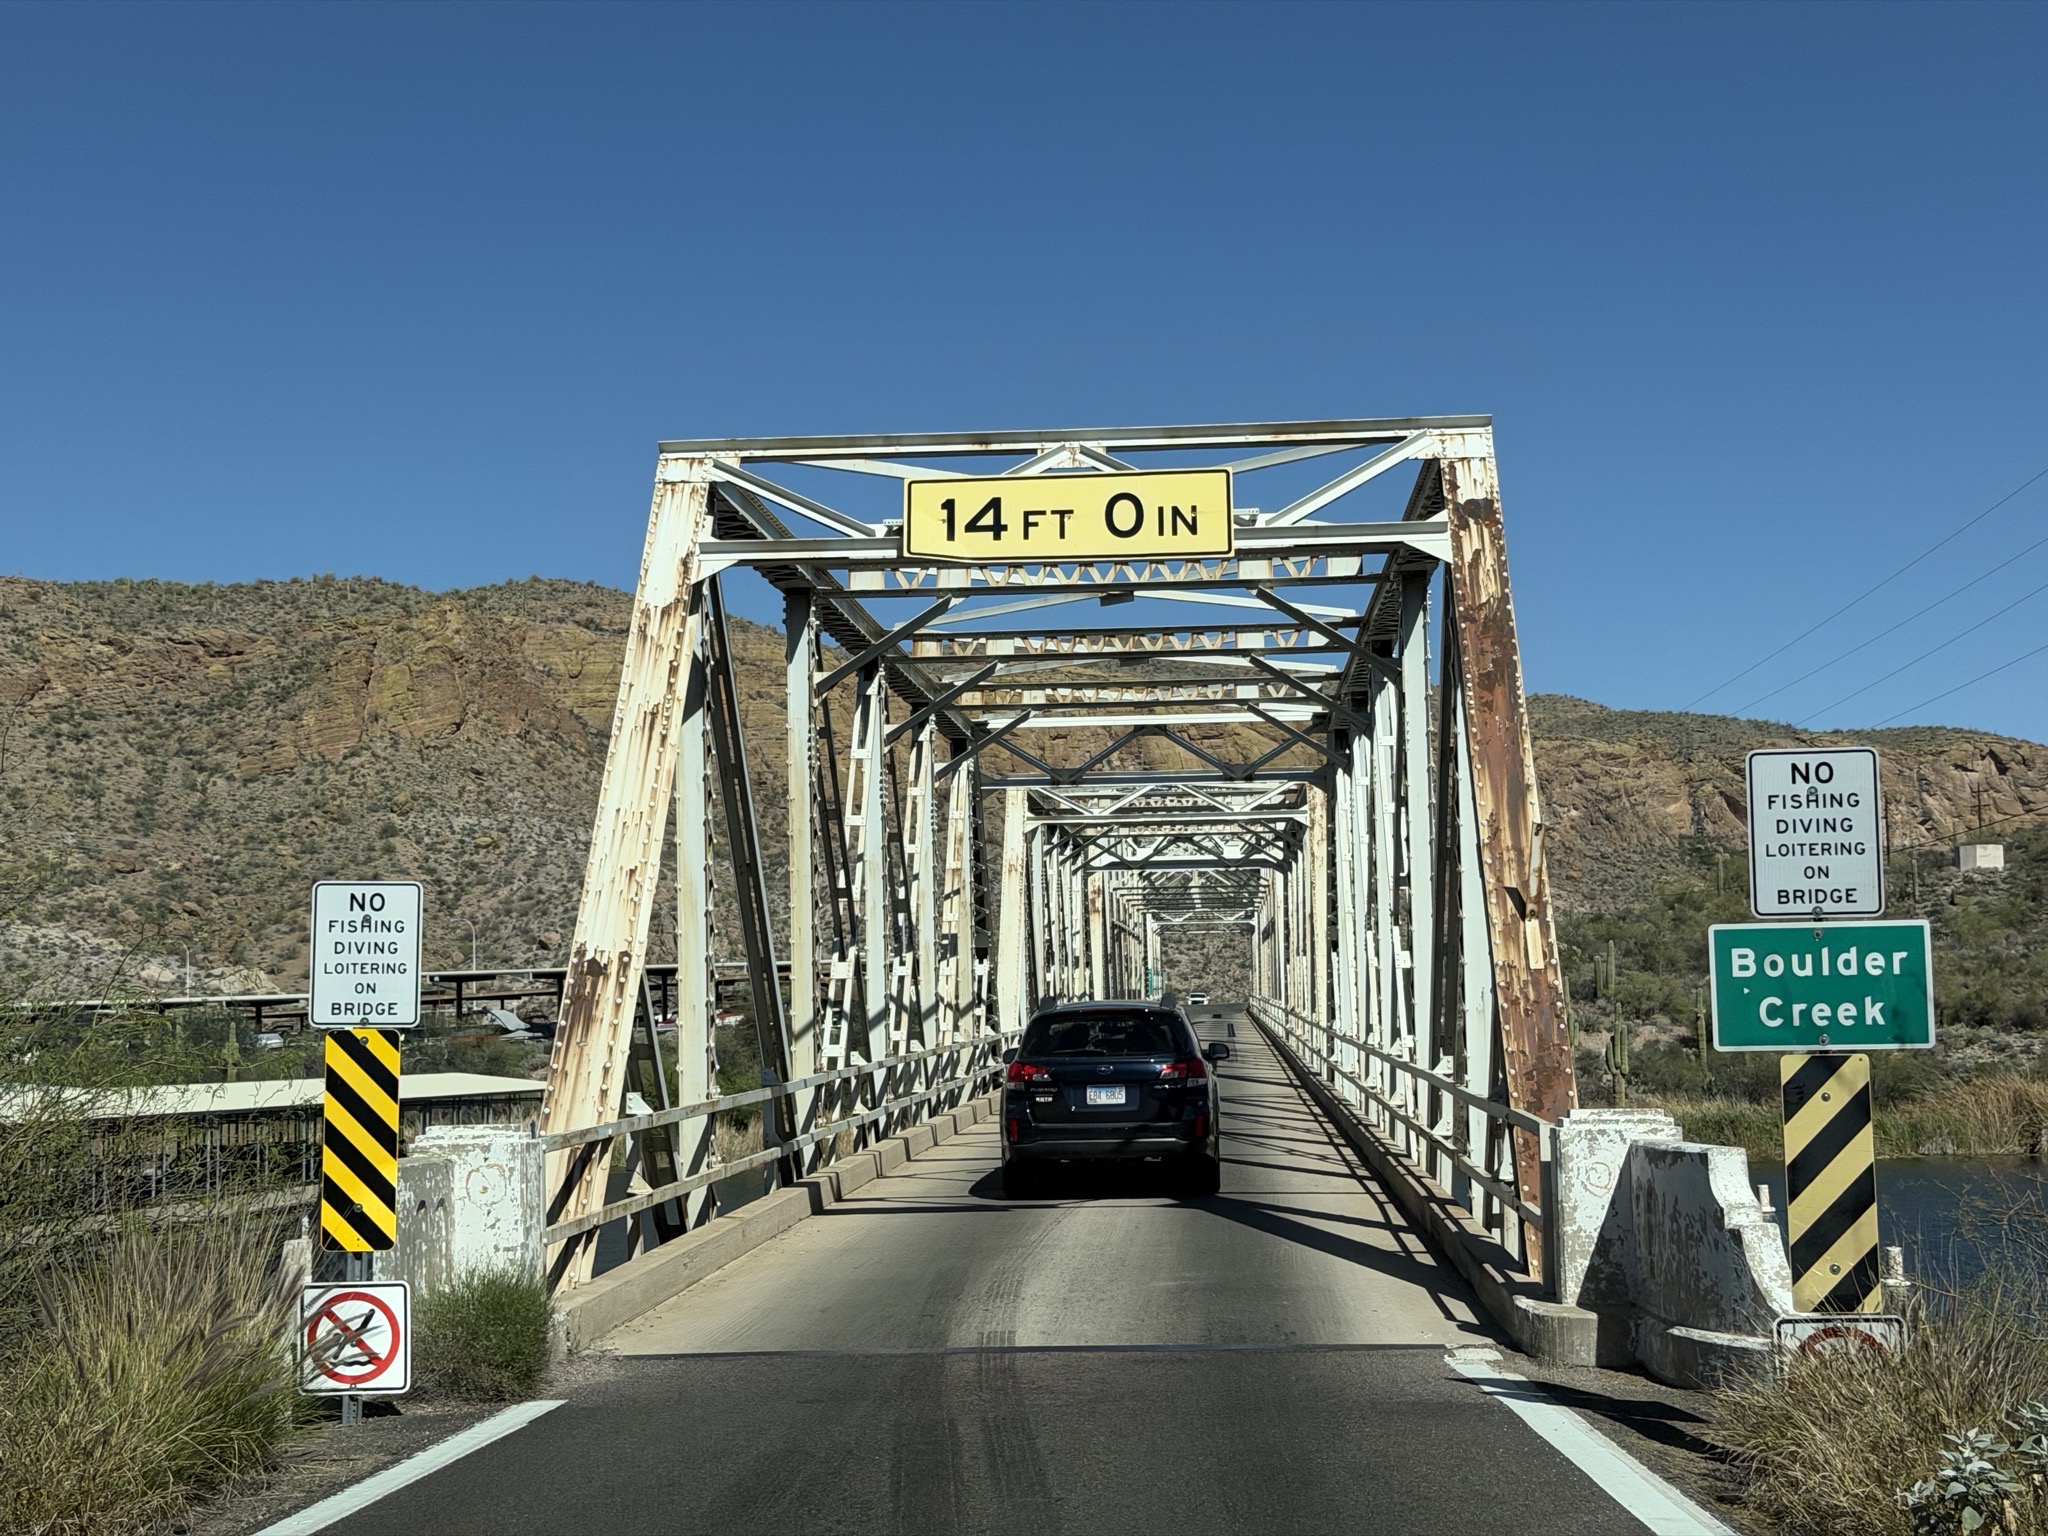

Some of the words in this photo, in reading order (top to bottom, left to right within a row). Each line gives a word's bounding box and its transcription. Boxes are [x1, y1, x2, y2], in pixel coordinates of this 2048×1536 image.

[940, 496, 1009, 542] 14
[1023, 509, 1075, 541] FT
[1157, 504, 1198, 537] IN
[1790, 761, 1834, 785] NO
[1767, 791, 1860, 810] FISHING
[1776, 817, 1853, 835] DIVING
[1765, 841, 1866, 858] LOITERING
[1803, 865, 1830, 880] ON
[349, 892, 386, 912] NO
[1777, 887, 1858, 905] BRIDGE
[328, 917, 405, 934] FISHING
[334, 941, 399, 955] DIVING
[323, 962, 408, 975] LOITERING
[1731, 946, 1909, 978] Boulder
[354, 982, 377, 995] ON
[331, 1002, 398, 1016] BRIDGE
[1759, 995, 1886, 1028] Creek
